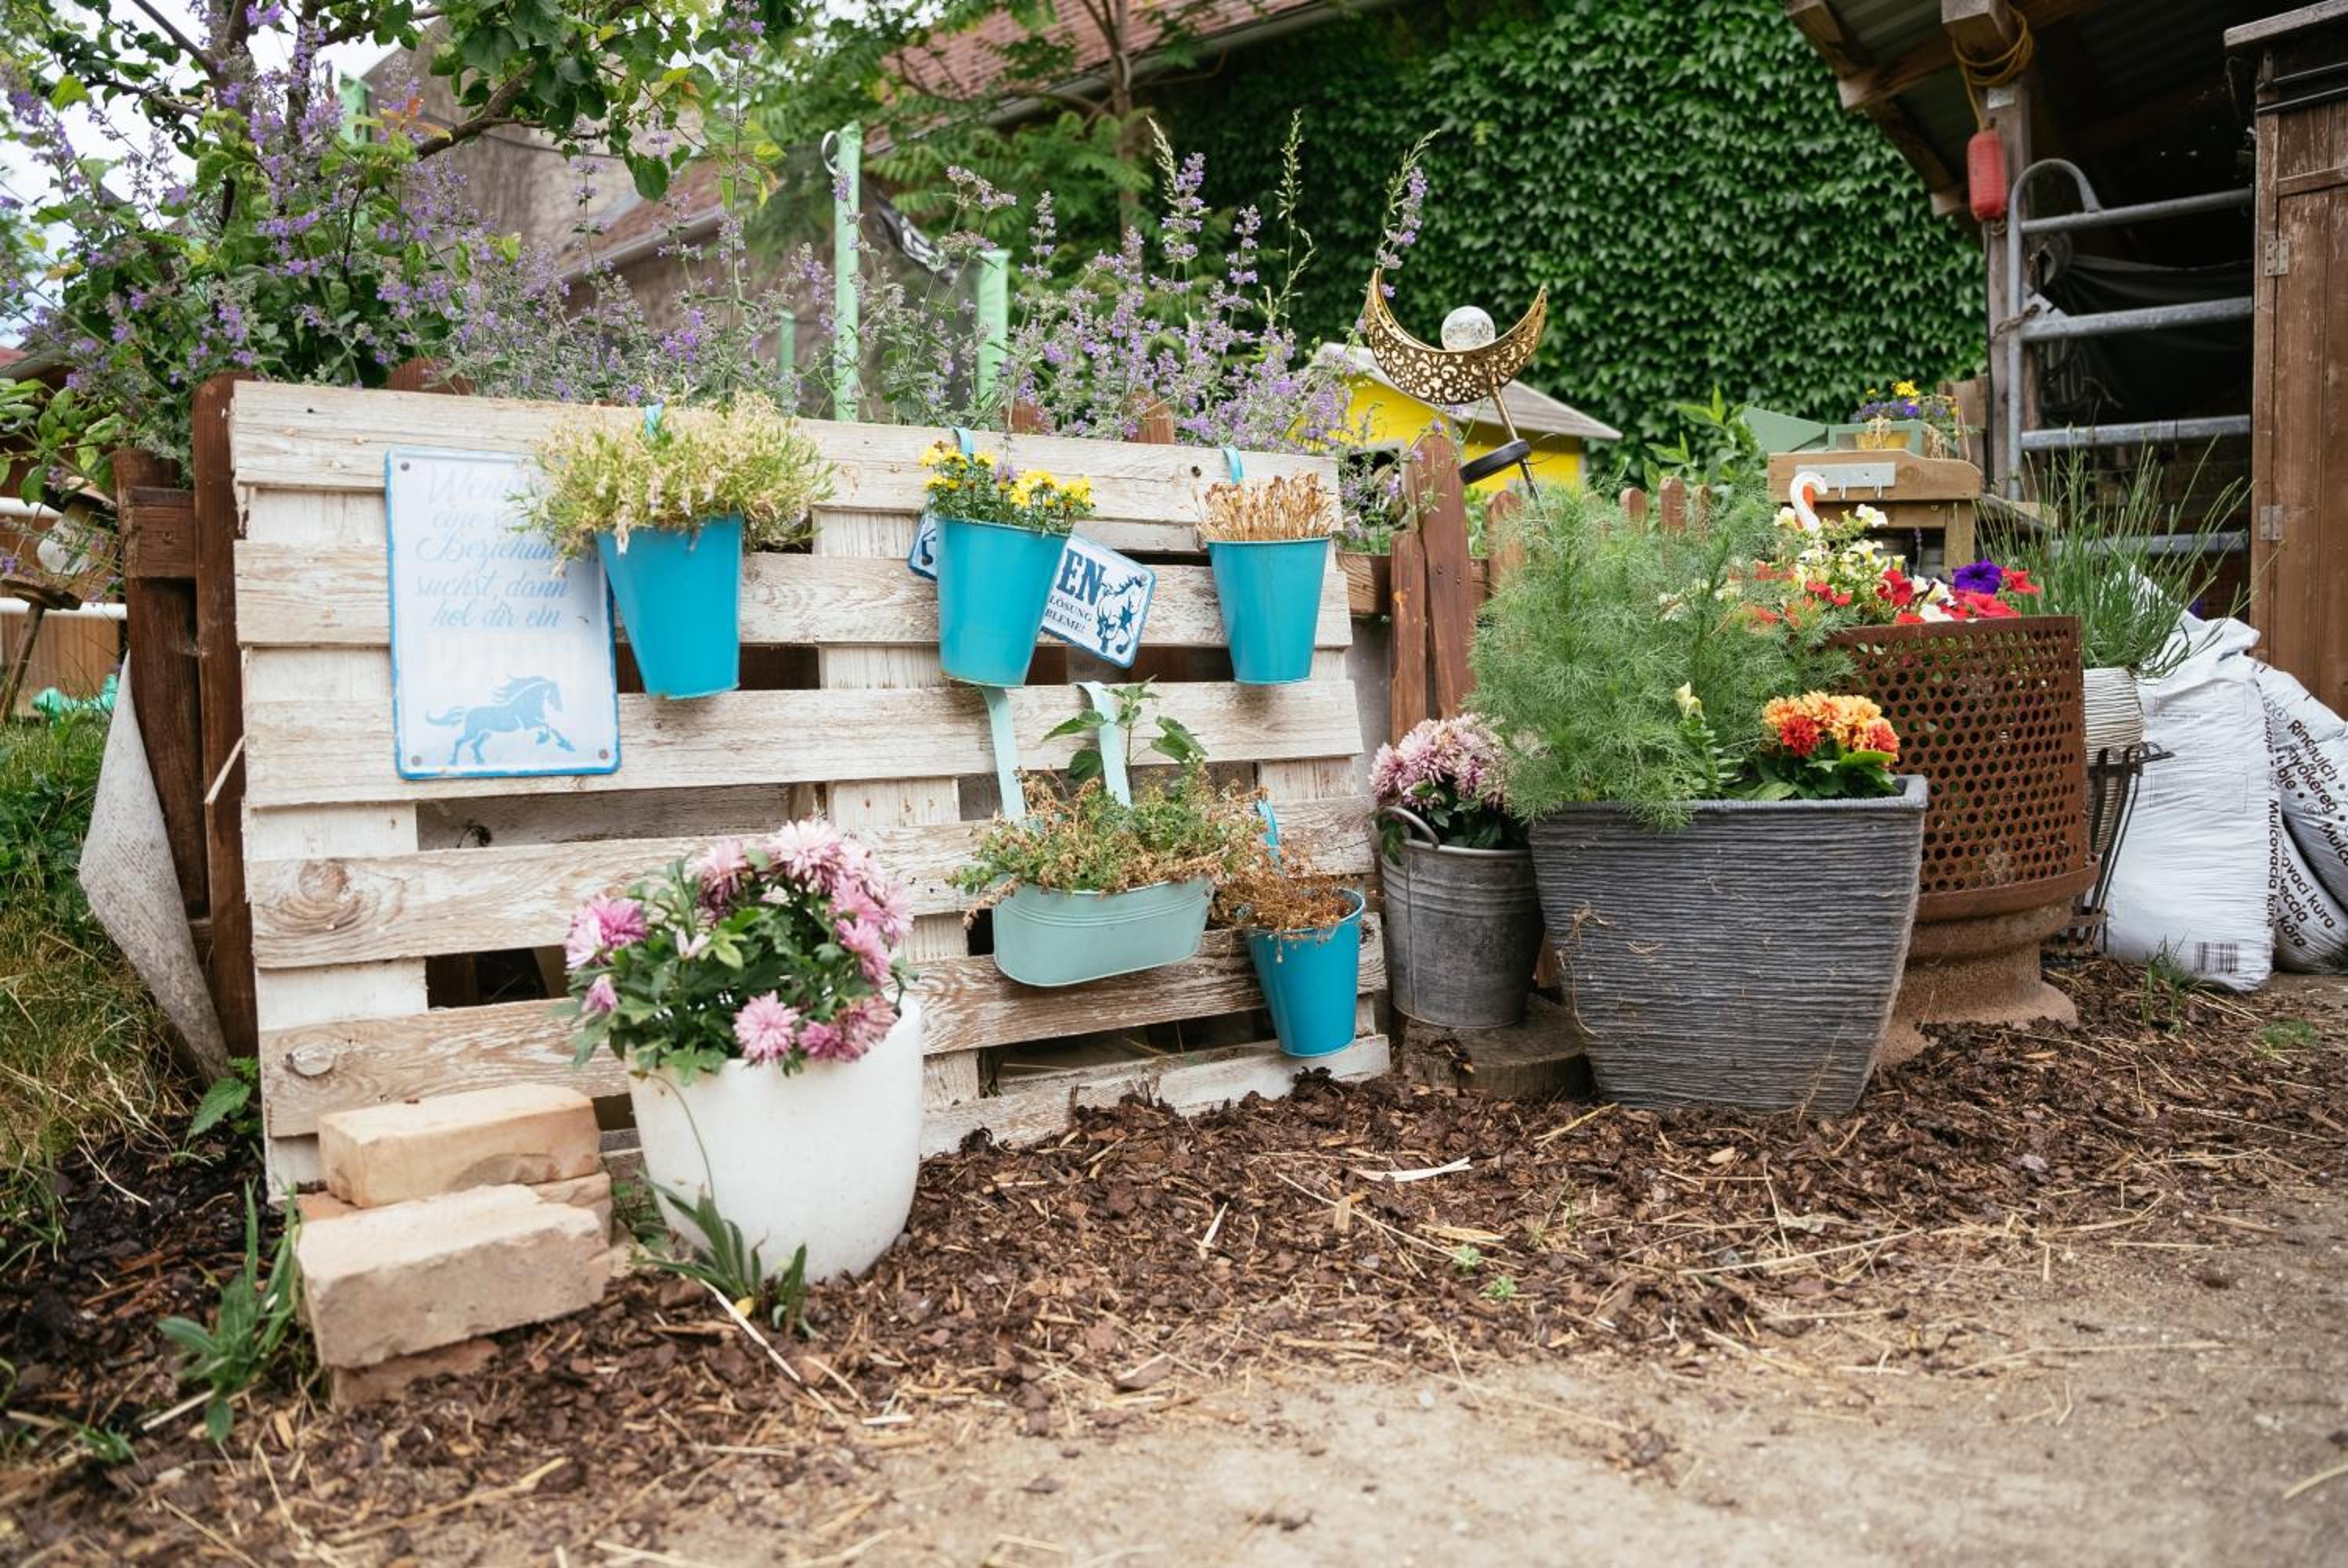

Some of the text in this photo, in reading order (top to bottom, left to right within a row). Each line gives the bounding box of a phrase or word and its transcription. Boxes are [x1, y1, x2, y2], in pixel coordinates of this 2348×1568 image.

[415, 530, 556, 573] Beziehun
[504, 570, 569, 598] dann
[427, 600, 564, 627] hol dir ein
